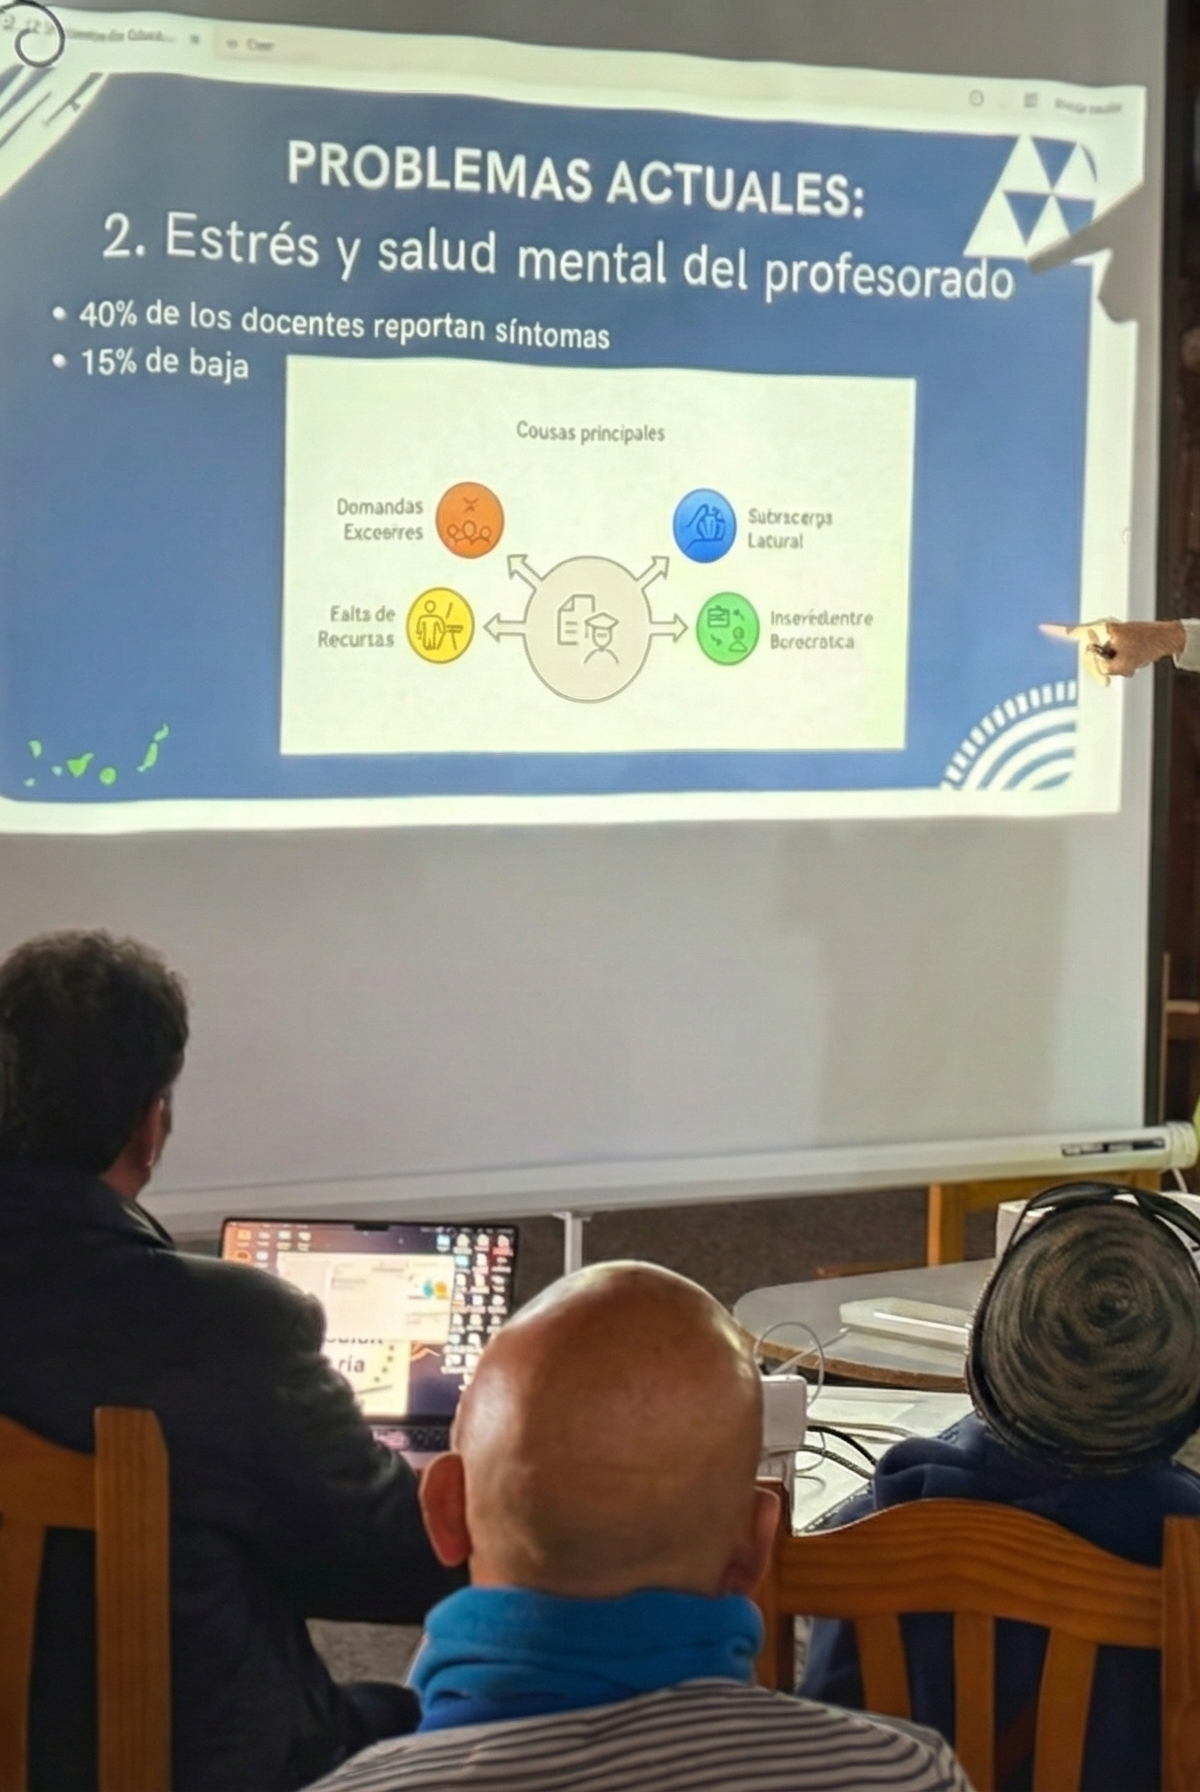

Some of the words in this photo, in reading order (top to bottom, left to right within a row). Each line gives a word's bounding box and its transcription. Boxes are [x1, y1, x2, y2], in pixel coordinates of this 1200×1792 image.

[289, 140, 592, 202] PROBLEMAS
[607, 161, 863, 218] ACTUALES:
[103, 213, 144, 257] 2.
[167, 212, 319, 267] Estrés
[337, 237, 360, 281] y
[379, 227, 495, 274] salud
[519, 241, 666, 283] mental
[684, 244, 747, 290] del
[766, 250, 1015, 303] profesorado
[80, 300, 137, 327] 40%
[147, 299, 179, 325] de
[191, 302, 231, 329] los
[242, 307, 364, 337] docentes
[375, 313, 484, 345] reportan
[496, 318, 609, 349] síntomas
[82, 348, 136, 375] 15%
[146, 346, 178, 373] de
[190, 348, 248, 384] baja
[581, 425, 665, 445] principales
[374, 605, 396, 623] de
